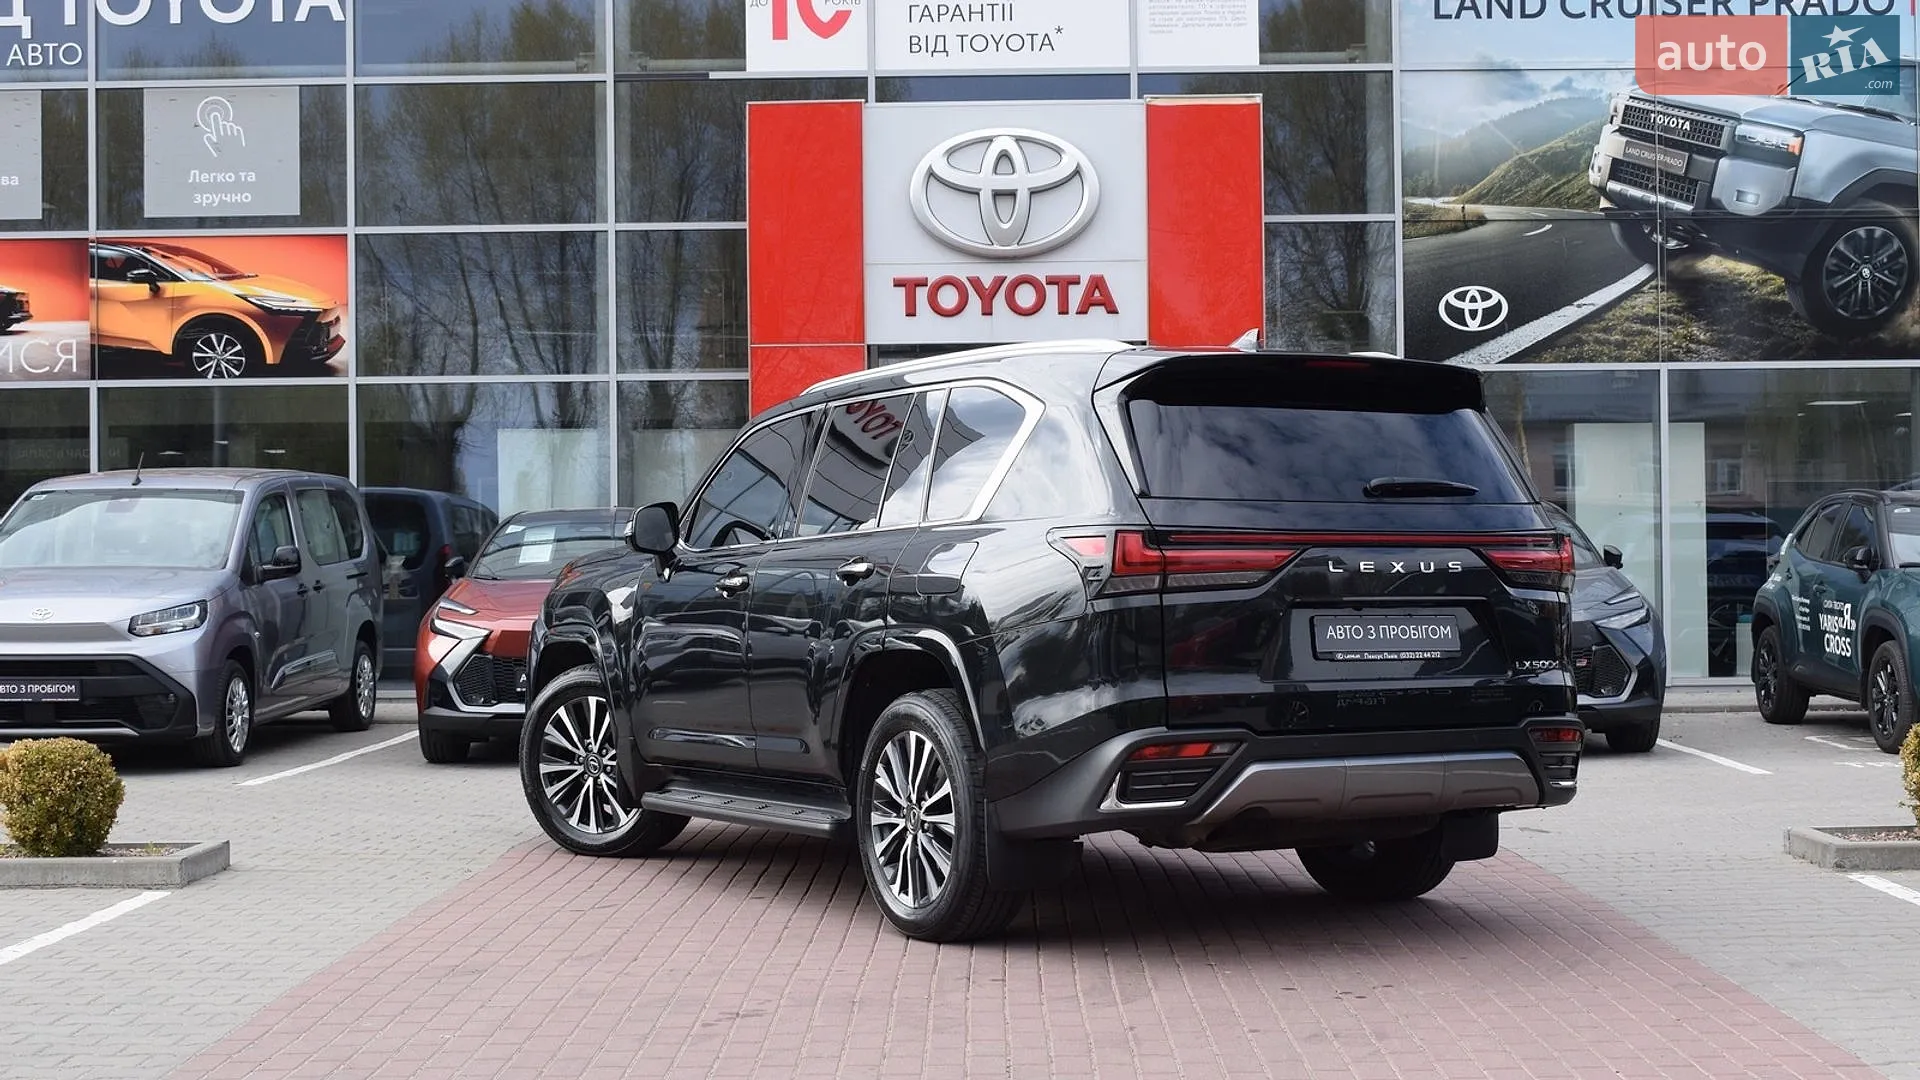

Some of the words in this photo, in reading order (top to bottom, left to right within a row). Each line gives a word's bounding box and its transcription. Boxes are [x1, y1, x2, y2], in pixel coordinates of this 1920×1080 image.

[1433, 0, 1548, 20] LAND
[1560, 0, 1737, 20] CRUISER
[1750, 0, 1895, 17] PRADO
[6, 43, 83, 66] АВТО
[909, 34, 949, 57] ВІД
[1650, 113, 1690, 131] TOYOTA
[188, 170, 235, 183] Легко
[239, 171, 256, 182] та
[193, 191, 251, 207] зручно
[893, 274, 1119, 317] TOYOTA
[1327, 560, 1463, 574] LEXUS
[1326, 625, 1364, 640] АВТО
[1367, 625, 1377, 639] З
[1379, 624, 1452, 639] ПРОБІГОМ
[1818, 613, 1839, 633] YARIS
[1824, 633, 1851, 657] CROSS
[0, 684, 18, 694] ВТО
[27, 683, 76, 694] ПРОБІГОМ
